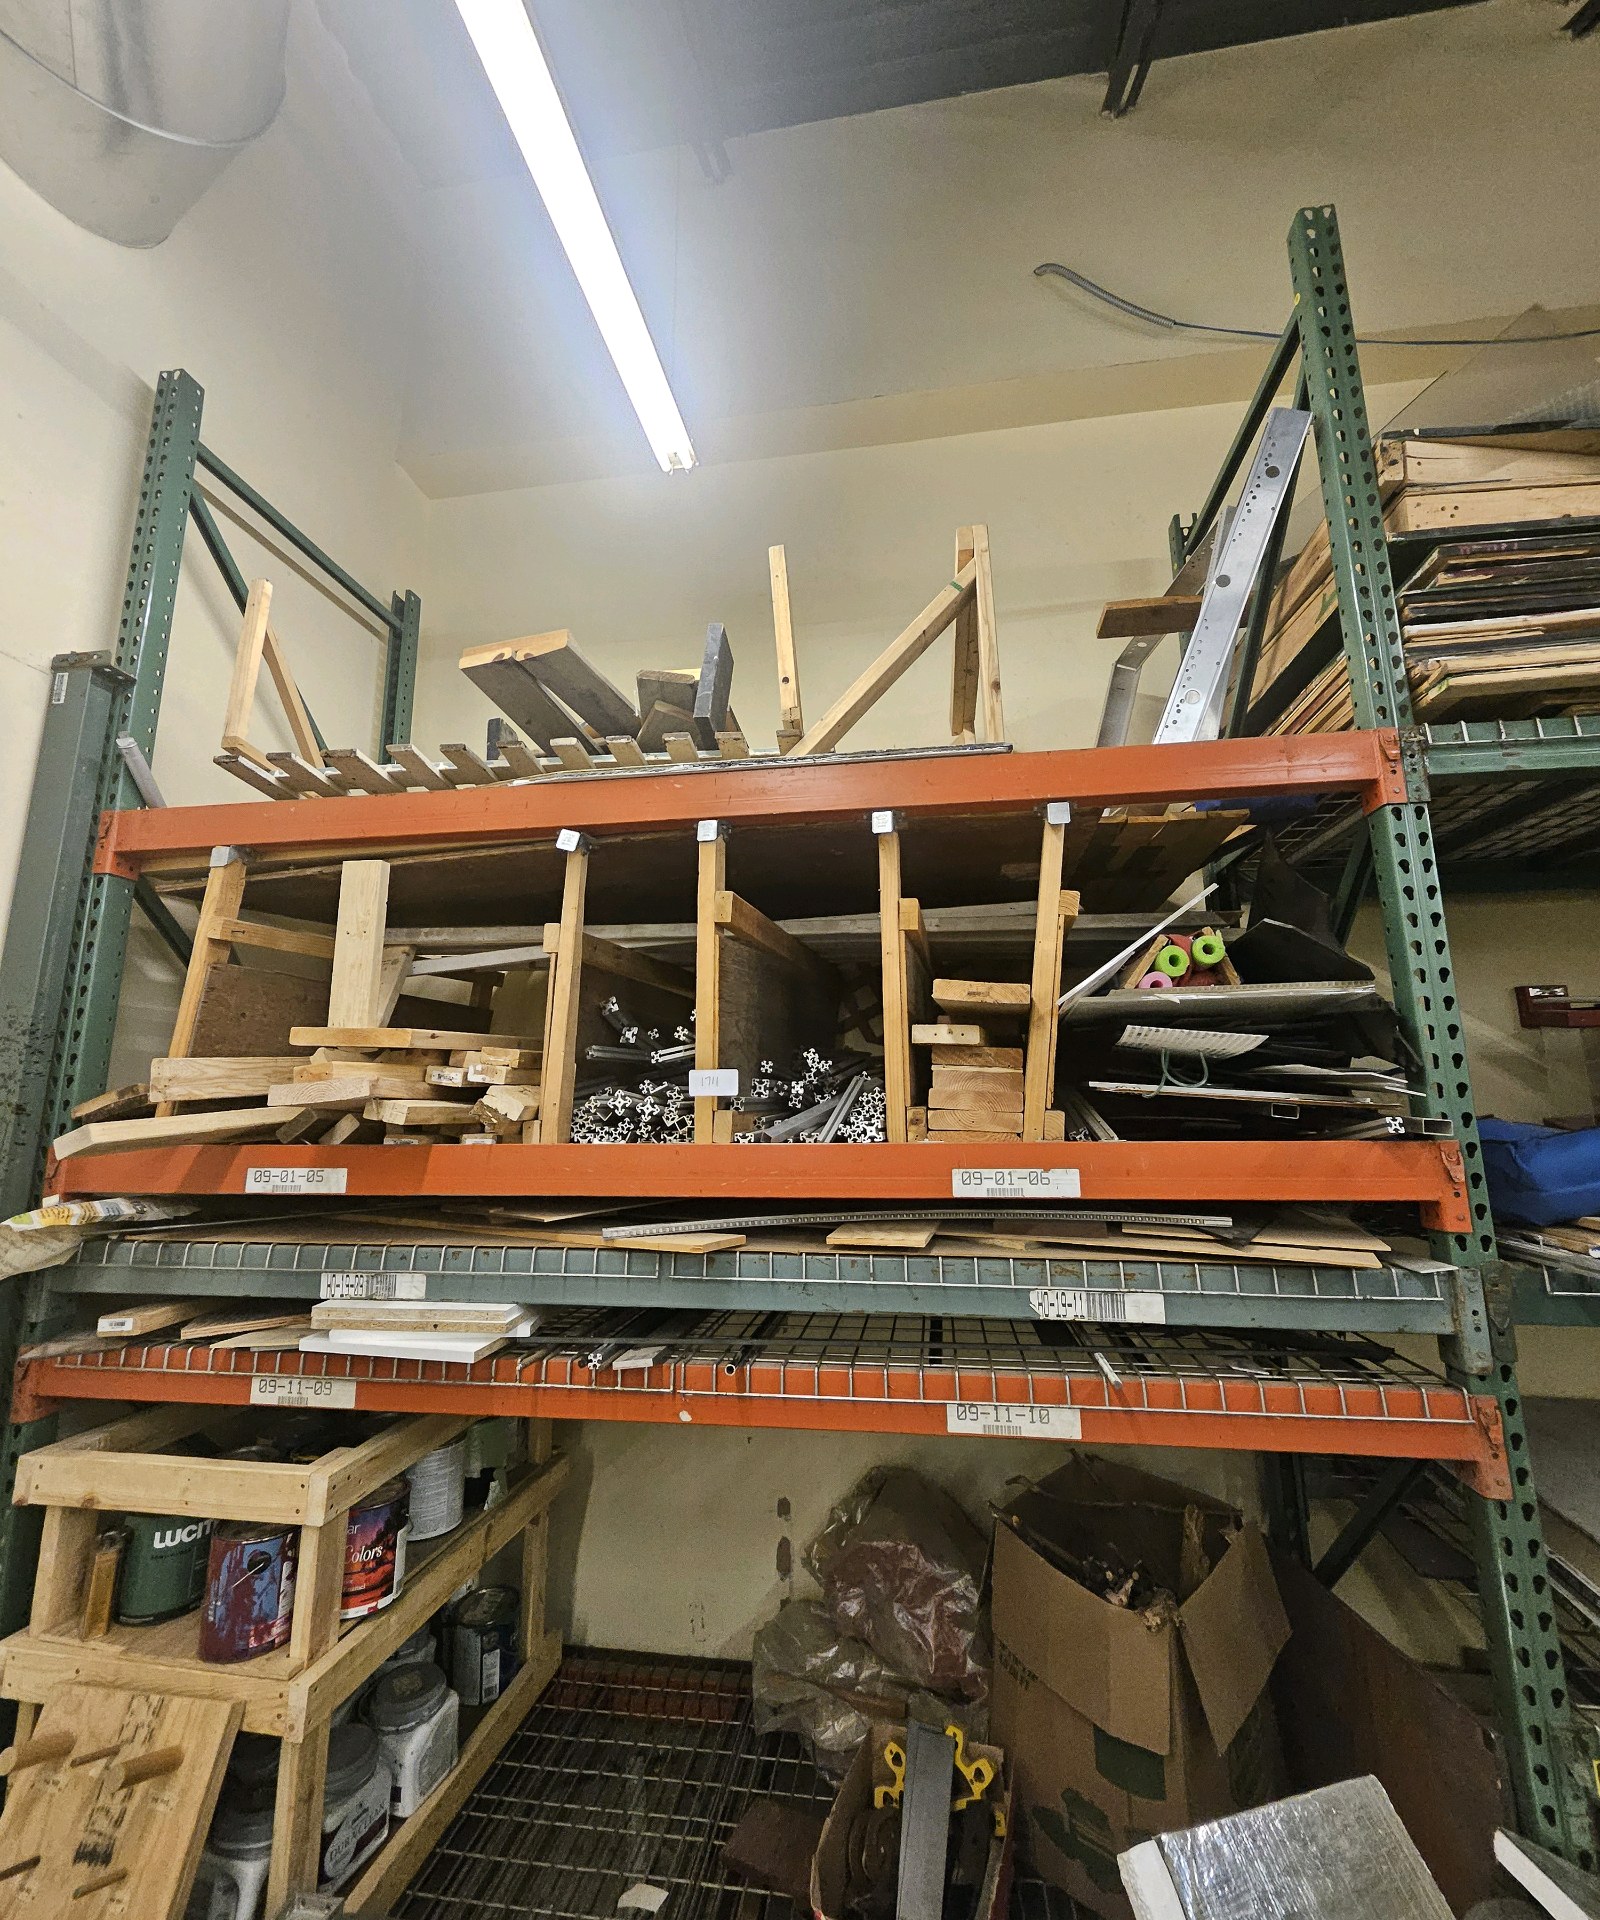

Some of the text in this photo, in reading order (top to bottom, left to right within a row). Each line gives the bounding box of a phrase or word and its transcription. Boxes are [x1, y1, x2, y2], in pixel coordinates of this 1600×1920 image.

[254, 1169, 325, 1183] 09-01-05
[961, 1170, 1051, 1186] 09-01-06
[258, 1379, 332, 1396] 09-11-09
[956, 1403, 1050, 1425] 09-11-10
[153, 1519, 217, 1549] LUCIT
